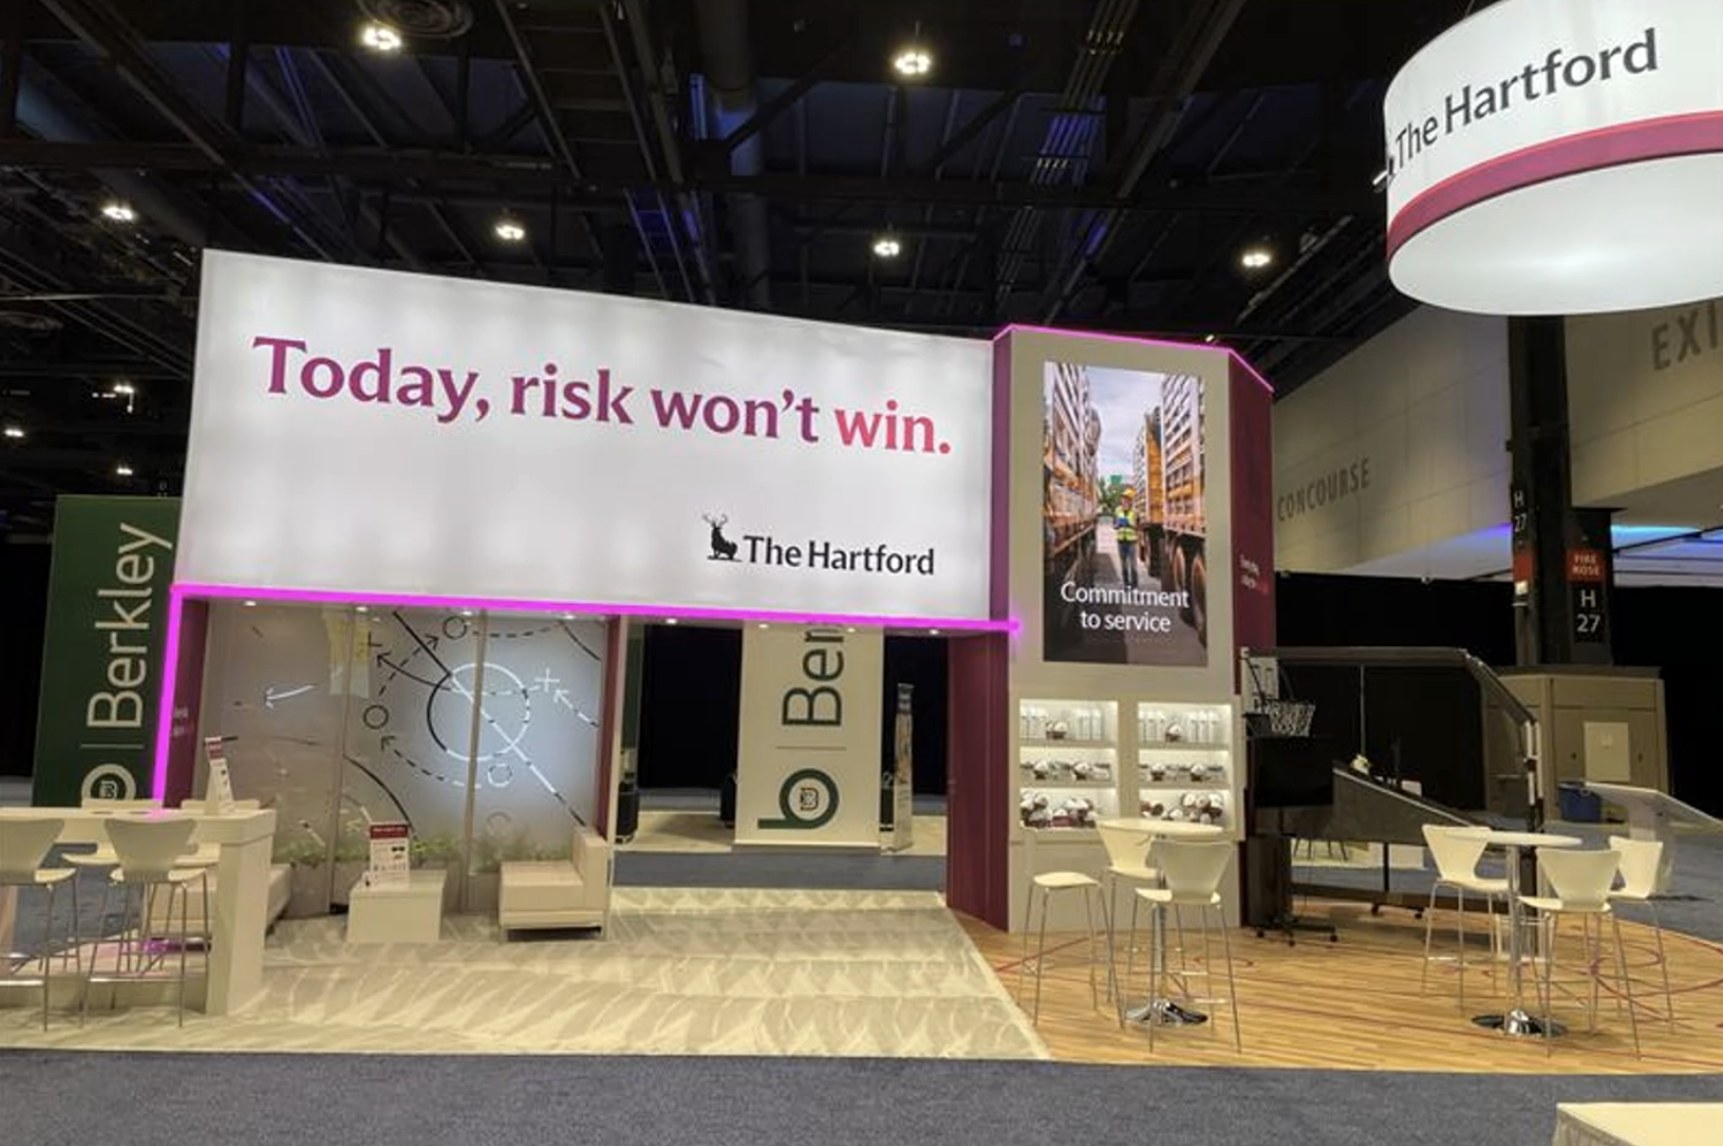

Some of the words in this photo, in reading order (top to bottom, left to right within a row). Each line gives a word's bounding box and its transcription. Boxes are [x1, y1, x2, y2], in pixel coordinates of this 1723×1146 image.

[1396, 115, 1438, 169] The
[1445, 27, 1658, 135] Hartford
[252, 336, 490, 424] Today,
[511, 363, 635, 425] risk
[650, 389, 819, 443] won't
[834, 399, 951, 454] win.
[1278, 458, 1369, 522] CONCOURSE
[743, 535, 801, 567] The
[808, 540, 934, 575] Hartford
[1574, 554, 1598, 564] FIRE
[1060, 581, 1190, 608] Commitment
[1581, 589, 1596, 608] H
[86, 522, 173, 728] Berkley
[1080, 611, 1101, 629] to
[1104, 612, 1171, 632] service
[1576, 614, 1600, 632] 27
